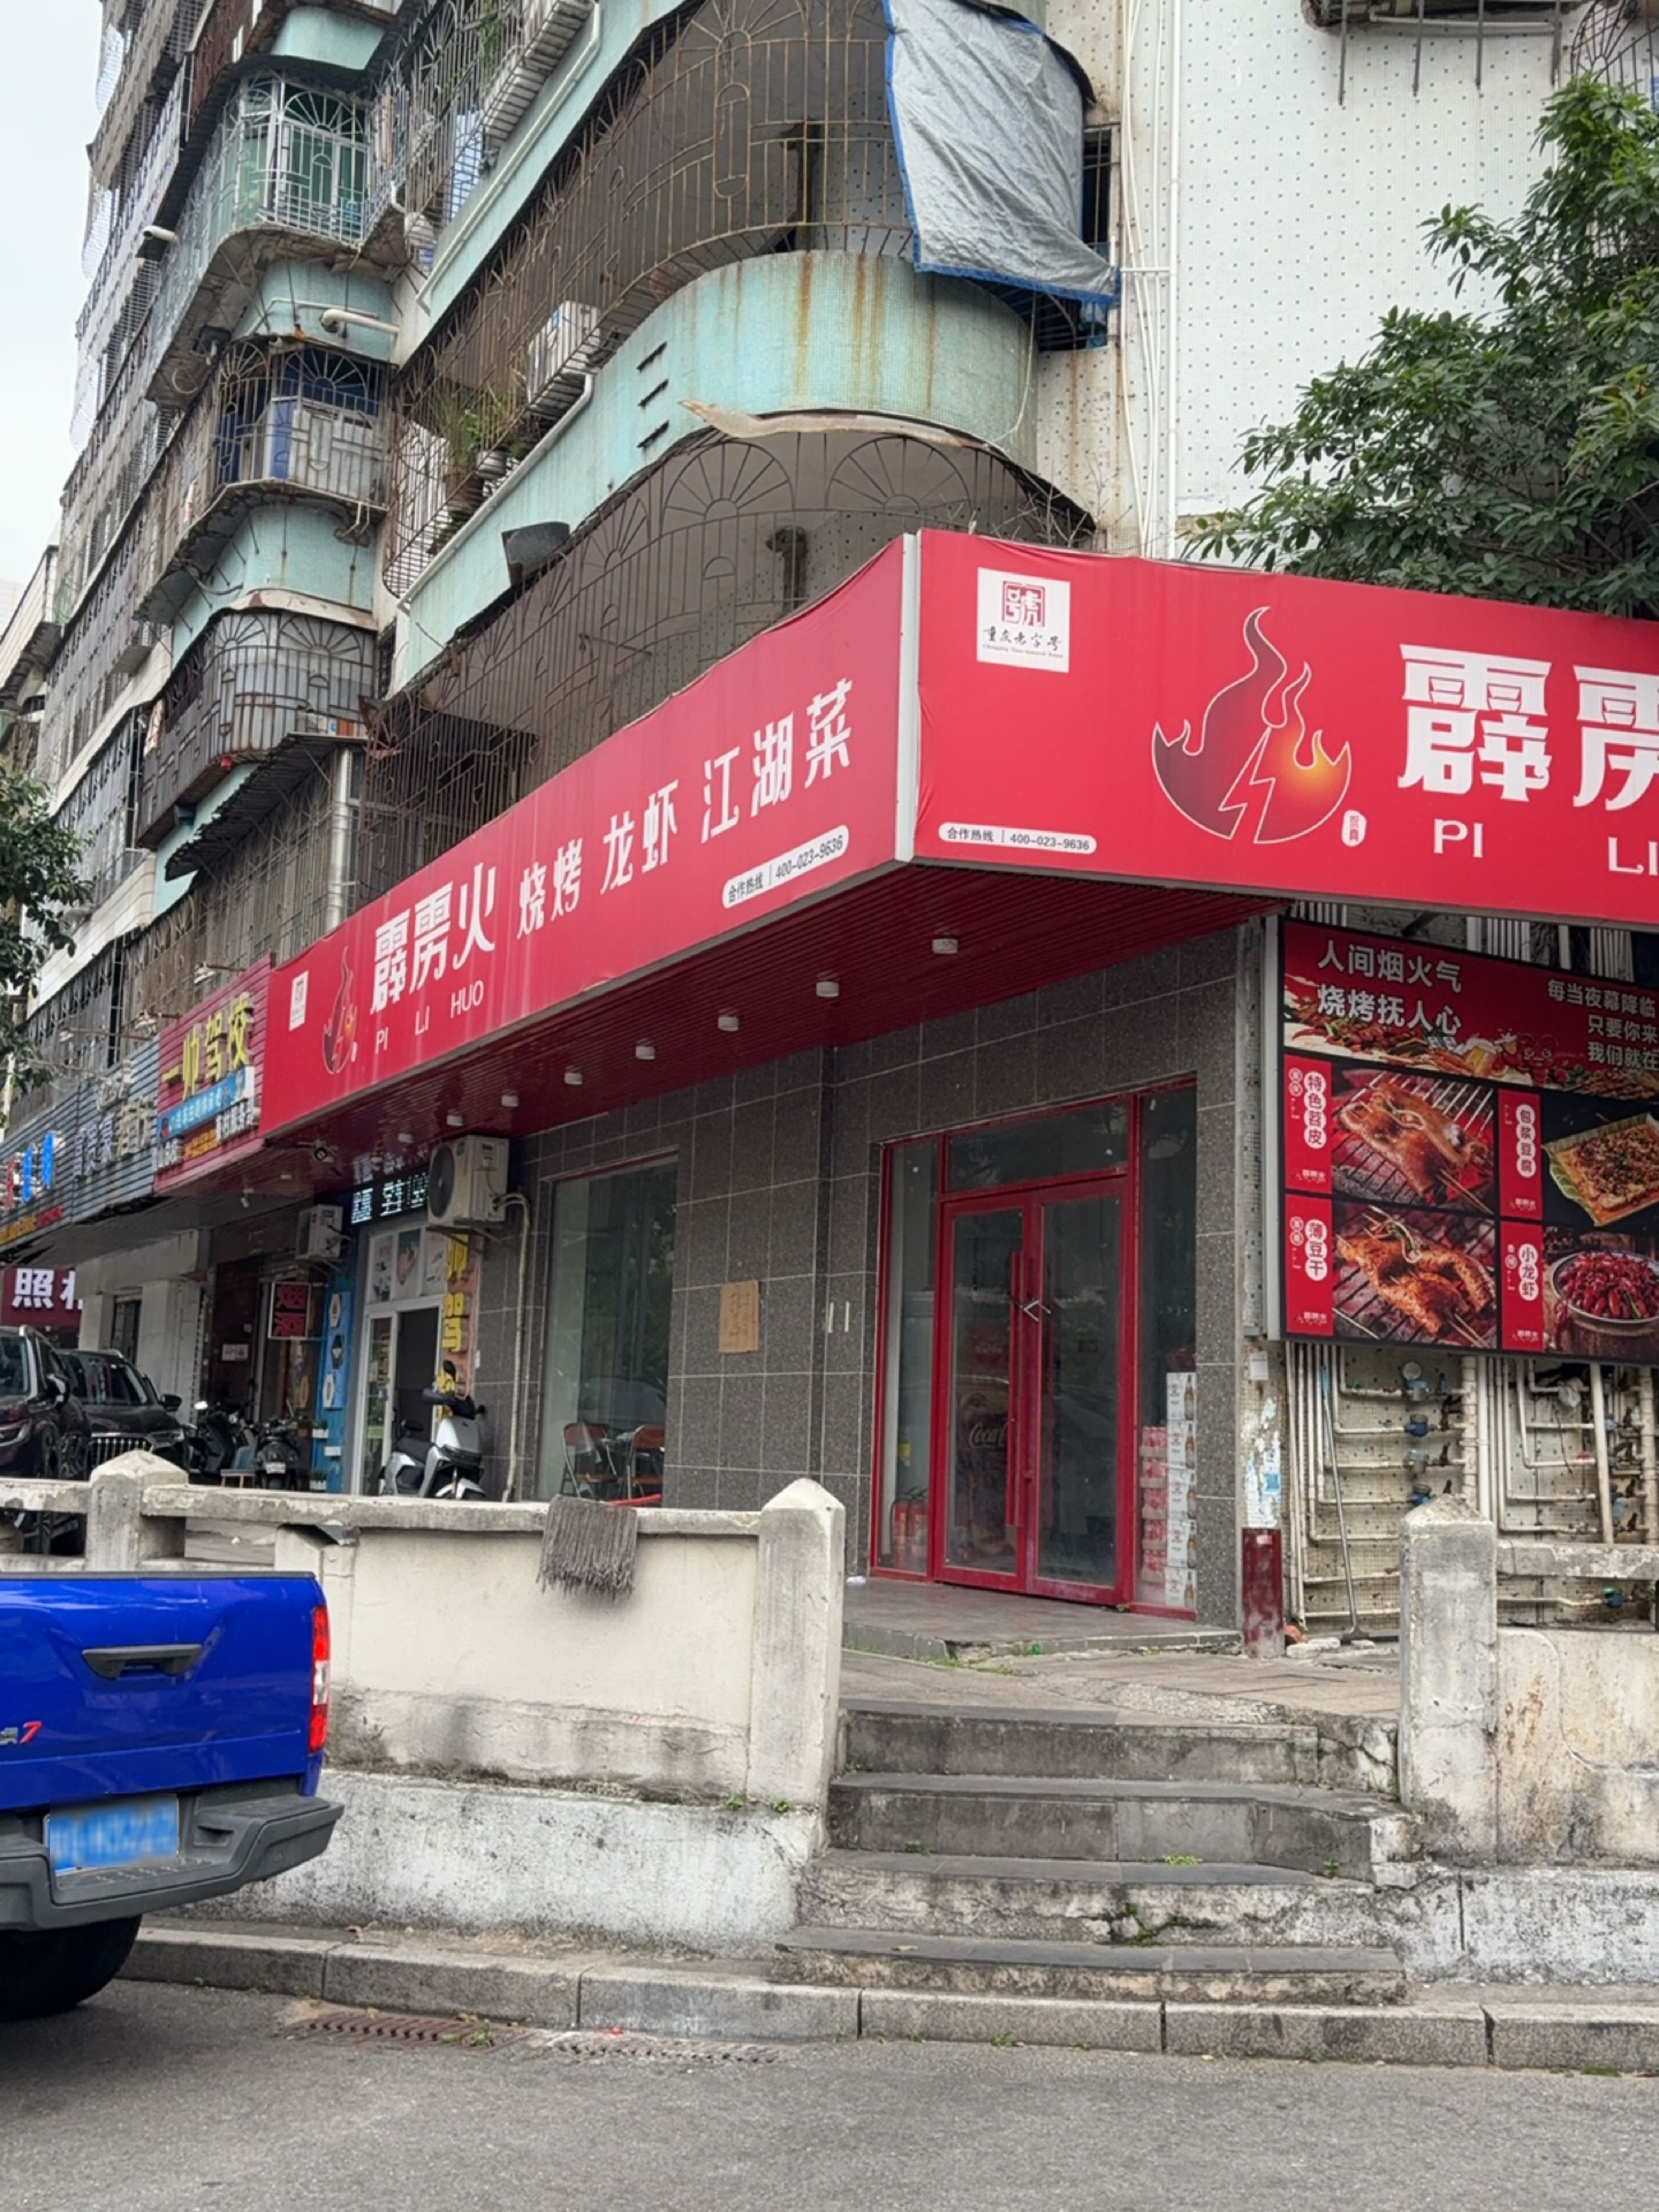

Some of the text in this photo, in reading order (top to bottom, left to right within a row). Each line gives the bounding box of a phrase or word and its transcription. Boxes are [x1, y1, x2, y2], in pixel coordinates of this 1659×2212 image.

[370, 678, 853, 1015] 霹雳火 烧烤 龙虾 江湖菜
[947, 827, 1089, 850] 合作热线 400-023-9636
[1433, 818, 1658, 876] PI LI
[728, 835, 843, 903] 合作热线 400-023-9636
[1318, 940, 1461, 993] 人间烟火气
[374, 980, 485, 1055] PI LI HUO
[1318, 983, 1462, 1035] 烧烤抚人心
[1548, 979, 1656, 1018] 每当夜幕降临
[1588, 1014, 1658, 1044] 只要你来
[1587, 1041, 1659, 1071] 我们就在
[1521, 1246, 1536, 1297] 小龙虾
